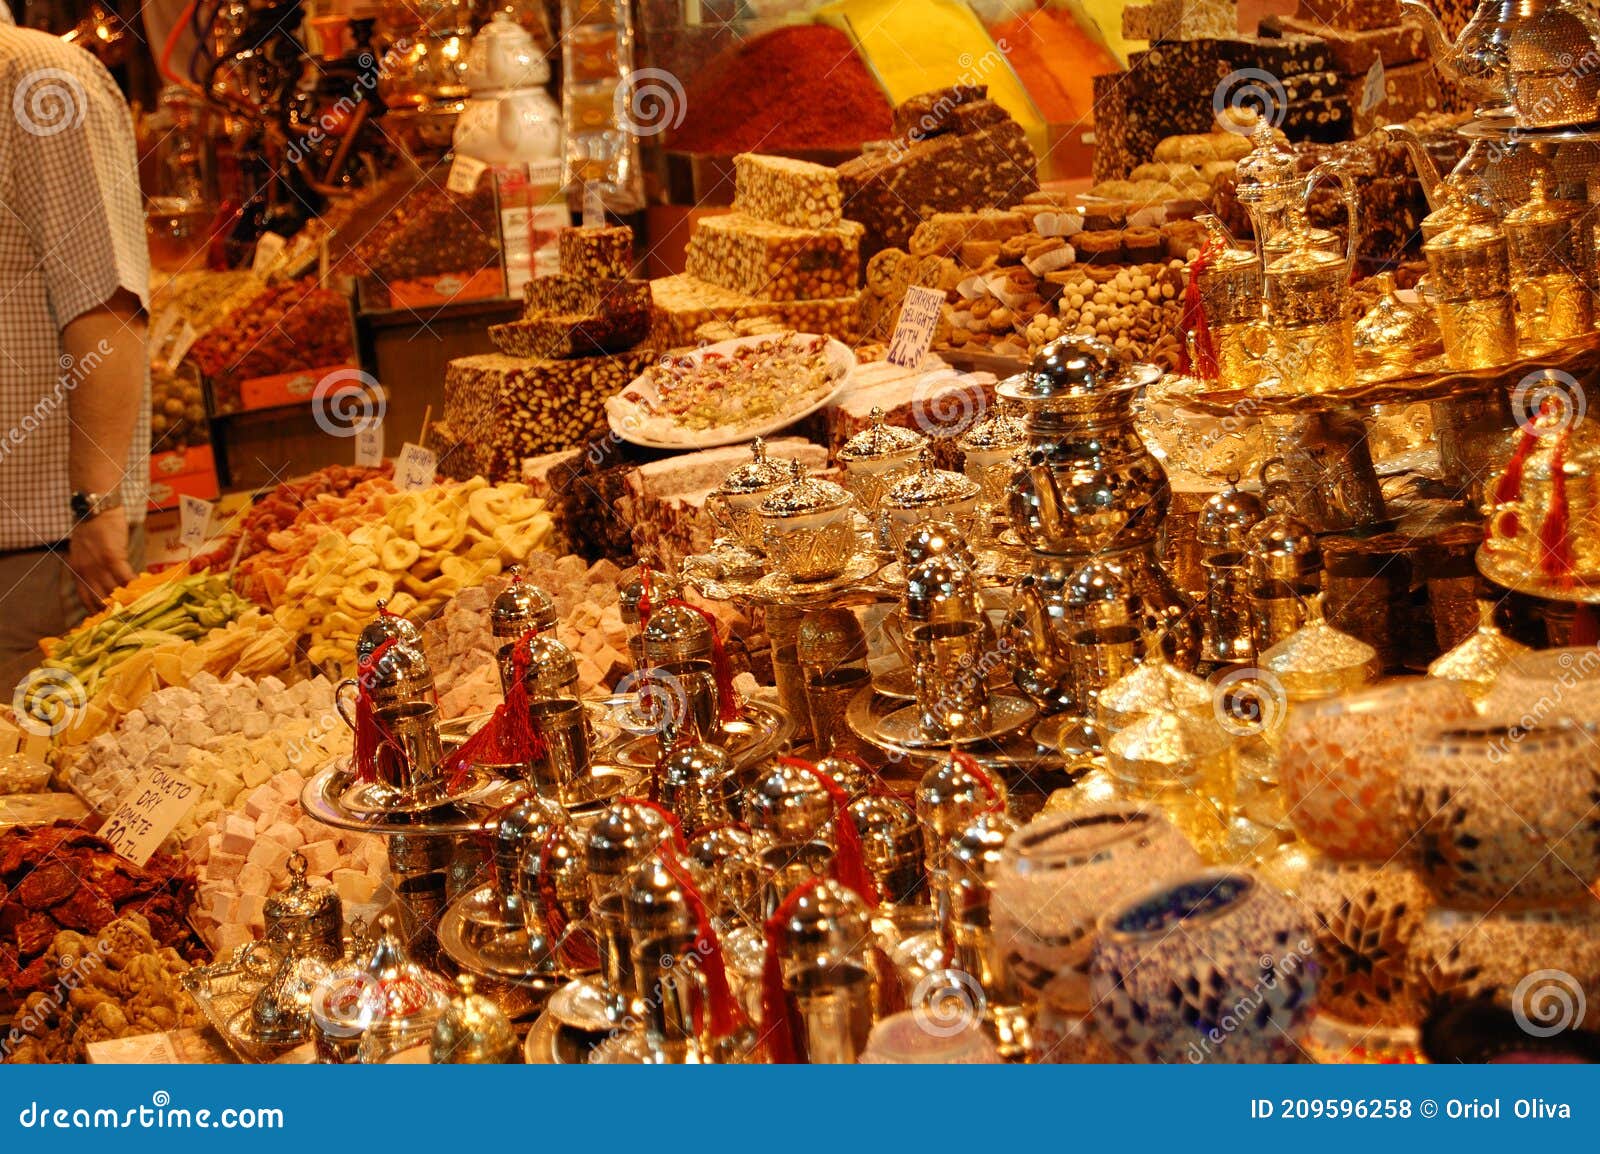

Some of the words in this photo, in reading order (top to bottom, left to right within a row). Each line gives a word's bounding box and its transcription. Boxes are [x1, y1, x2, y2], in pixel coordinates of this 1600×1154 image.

[895, 327, 919, 344] WITH
[148, 766, 192, 800] TOMATO
[136, 789, 163, 813] DRY
[115, 802, 153, 836] DOMATE
